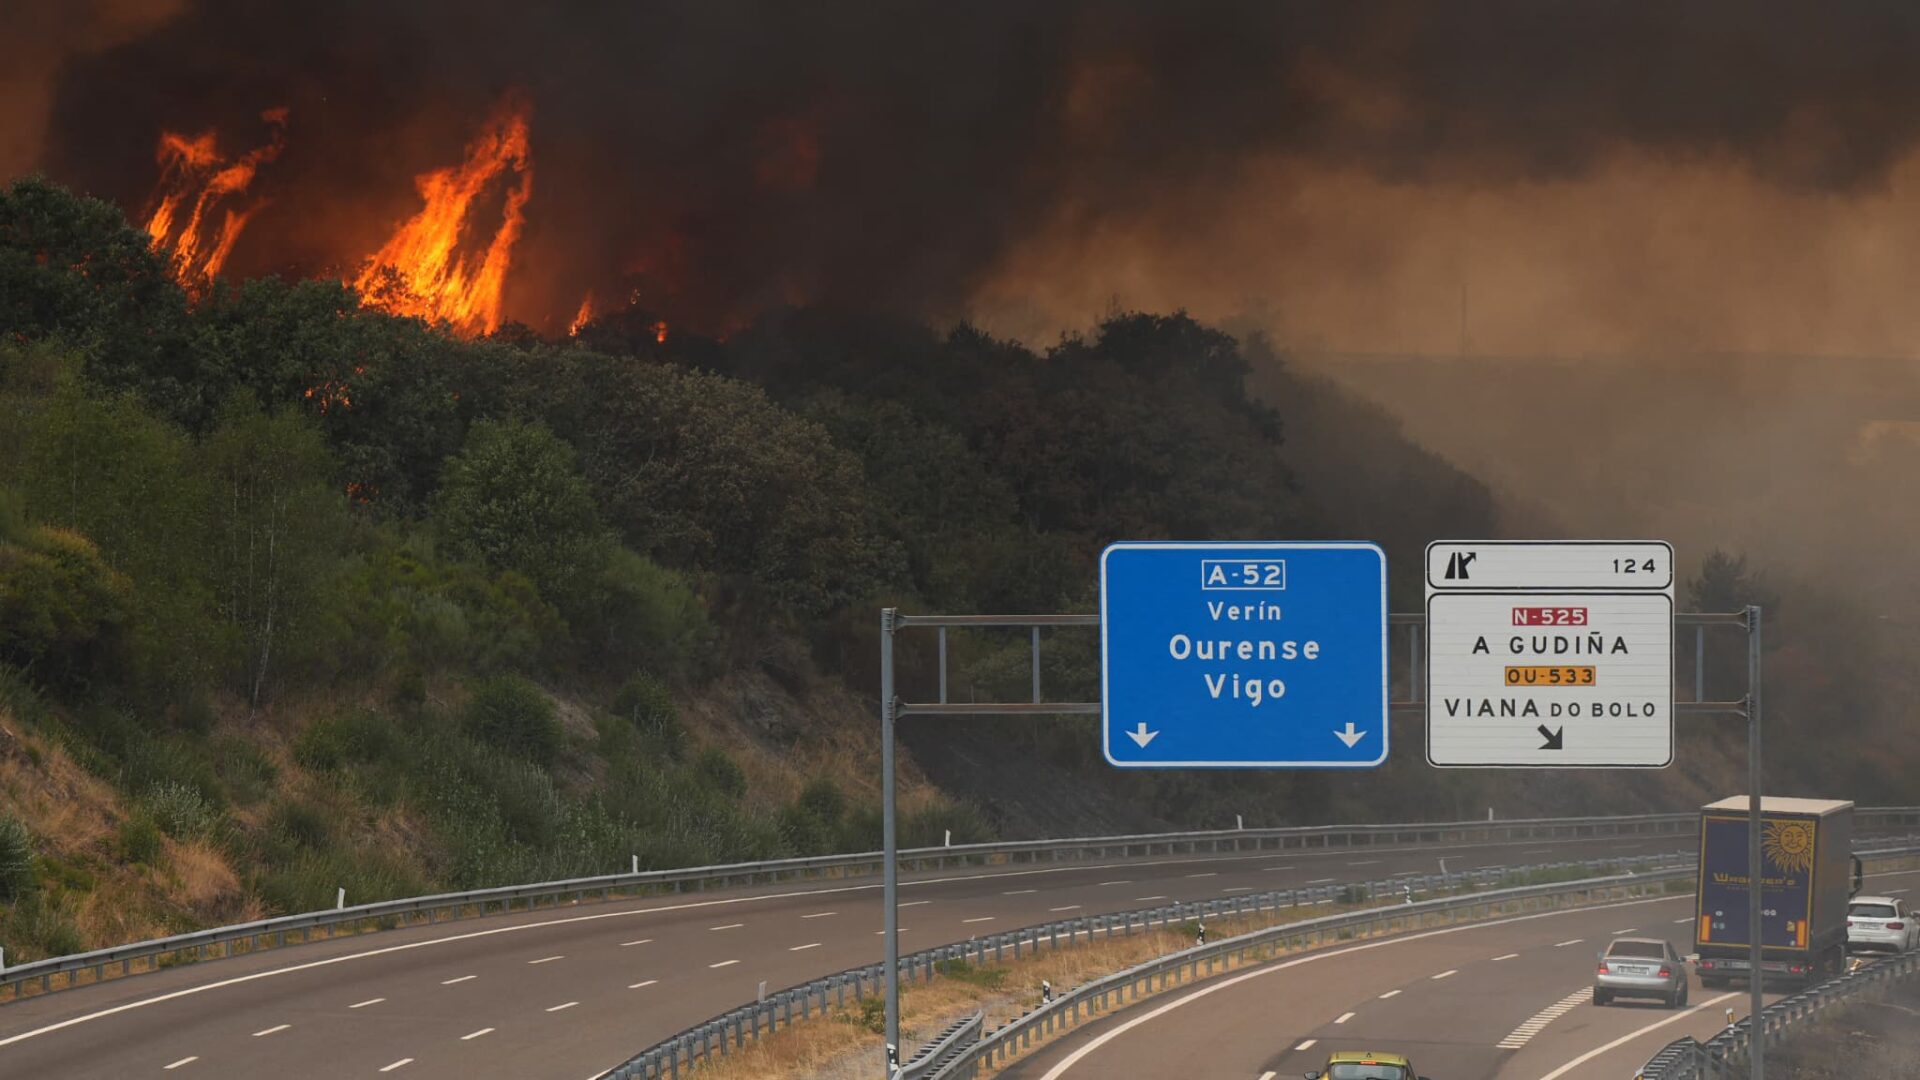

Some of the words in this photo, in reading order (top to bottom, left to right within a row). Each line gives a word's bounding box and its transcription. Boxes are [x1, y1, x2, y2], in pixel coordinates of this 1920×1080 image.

[1207, 564, 1281, 585] A-52
[1613, 558, 1656, 574] 124
[1207, 600, 1281, 621] Verín
[1514, 608, 1585, 625] N-525
[1169, 634, 1320, 660] Ourense
[1472, 636, 1490, 654] A
[1509, 631, 1629, 654] GUDIÑA
[1507, 668, 1593, 684] OU-533
[1204, 673, 1286, 707] Vigo
[1444, 698, 1540, 718] VIANA
[1550, 702, 1581, 717] DO
[1591, 702, 1655, 718] BOLO
